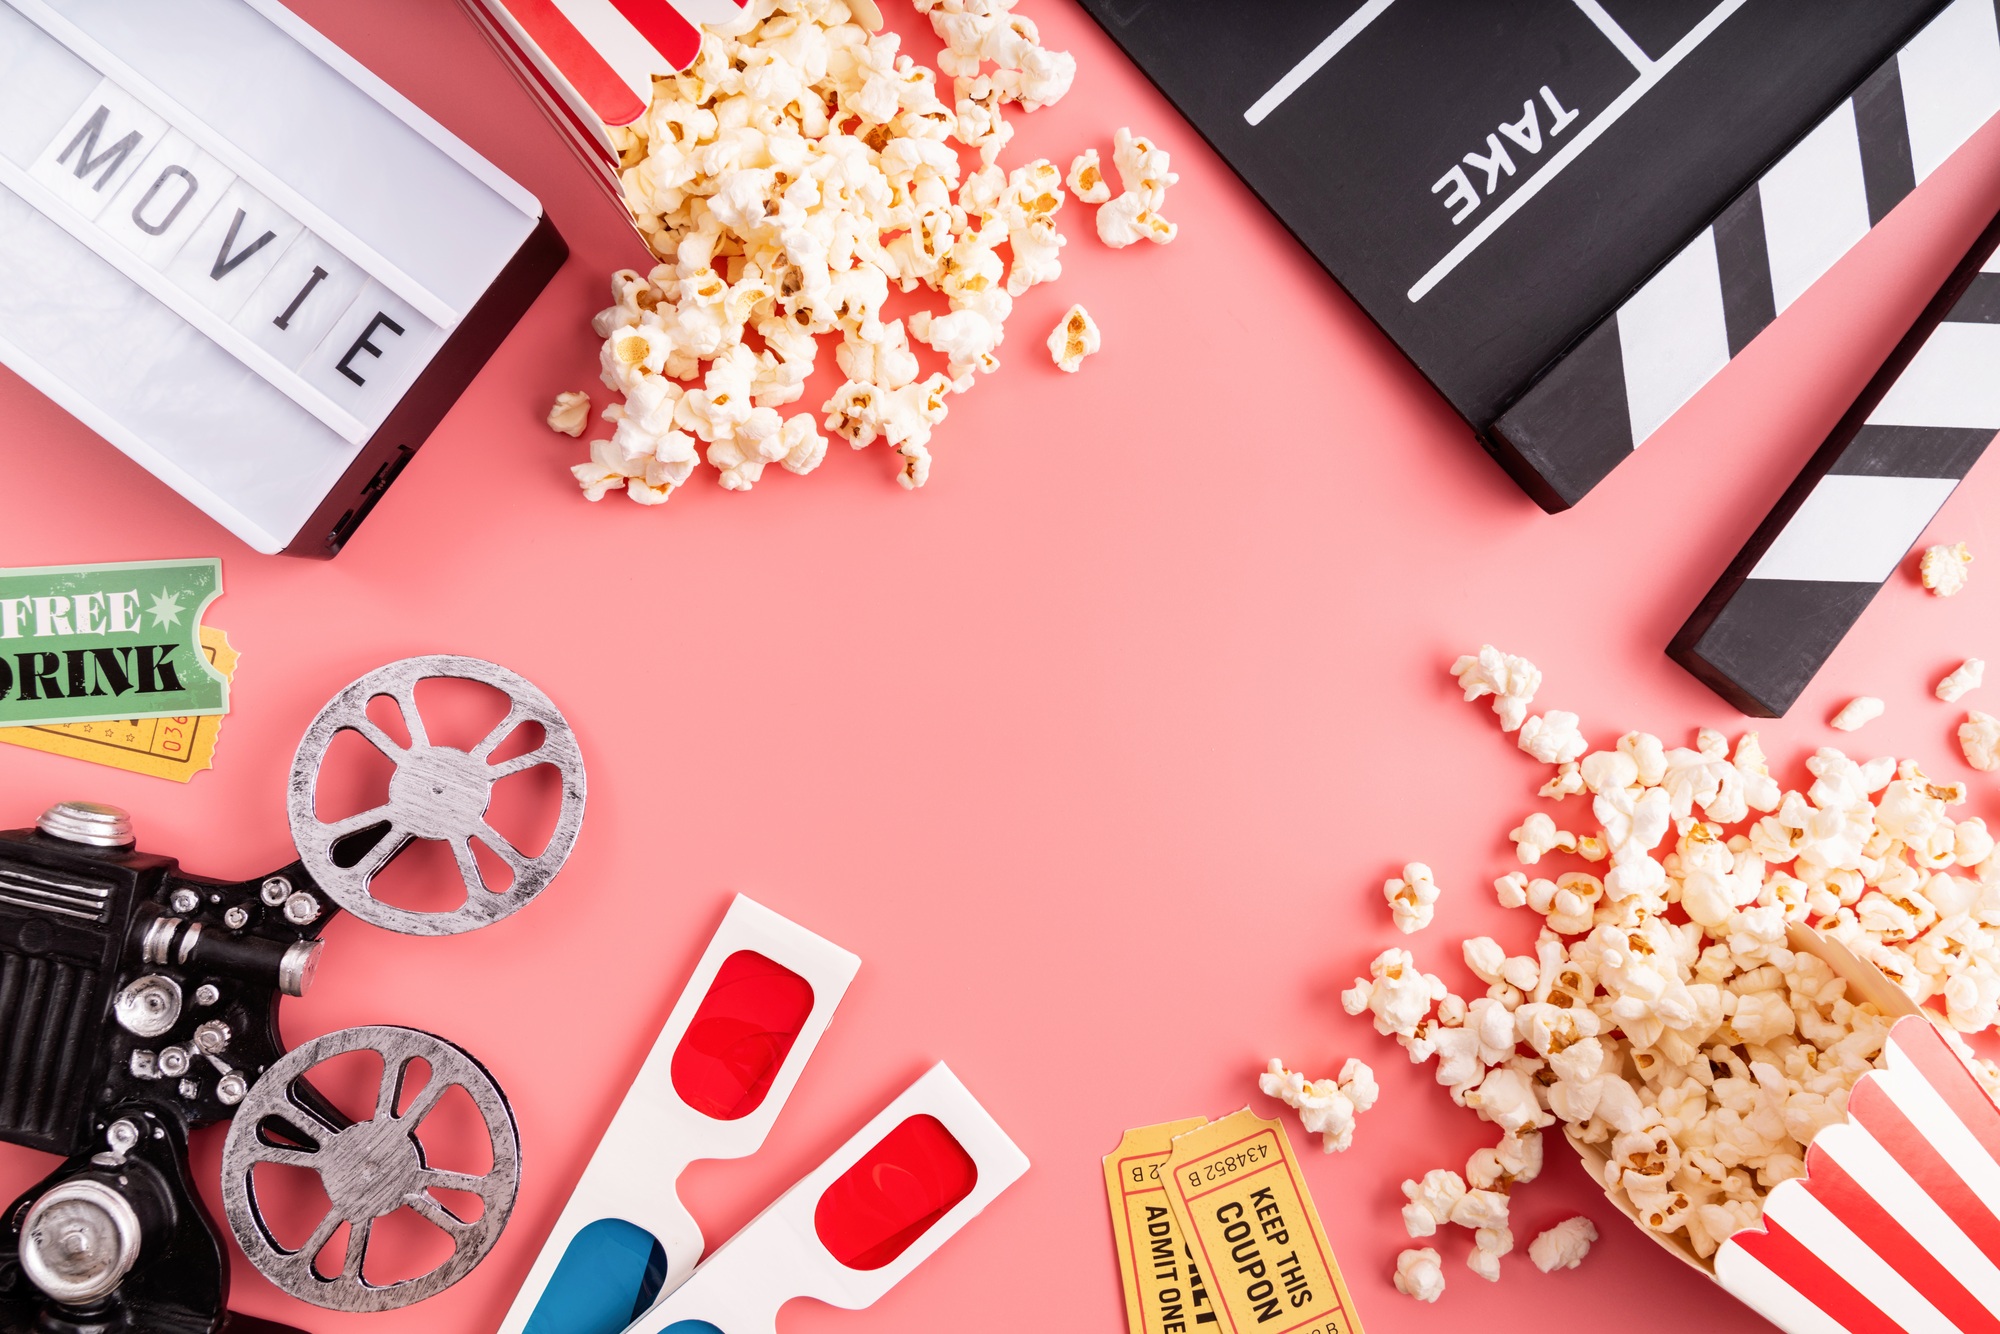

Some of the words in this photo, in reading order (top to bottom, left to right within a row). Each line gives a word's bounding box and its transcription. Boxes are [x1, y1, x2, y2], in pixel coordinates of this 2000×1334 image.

[1431, 85, 1580, 226] TAKE
[56, 104, 406, 388] MOVIE
[0, 588, 142, 639] FREE
[1132, 1166, 1144, 1182] B
[1188, 1171, 1202, 1187] B
[1204, 1144, 1268, 1181] 434852
[1145, 1206, 1179, 1282] ADMIT
[1216, 1201, 1283, 1324] COUPON
[1249, 1186, 1290, 1246] KEEP
[1276, 1250, 1313, 1308] THIS
[1158, 1287, 1187, 1334] ONE
